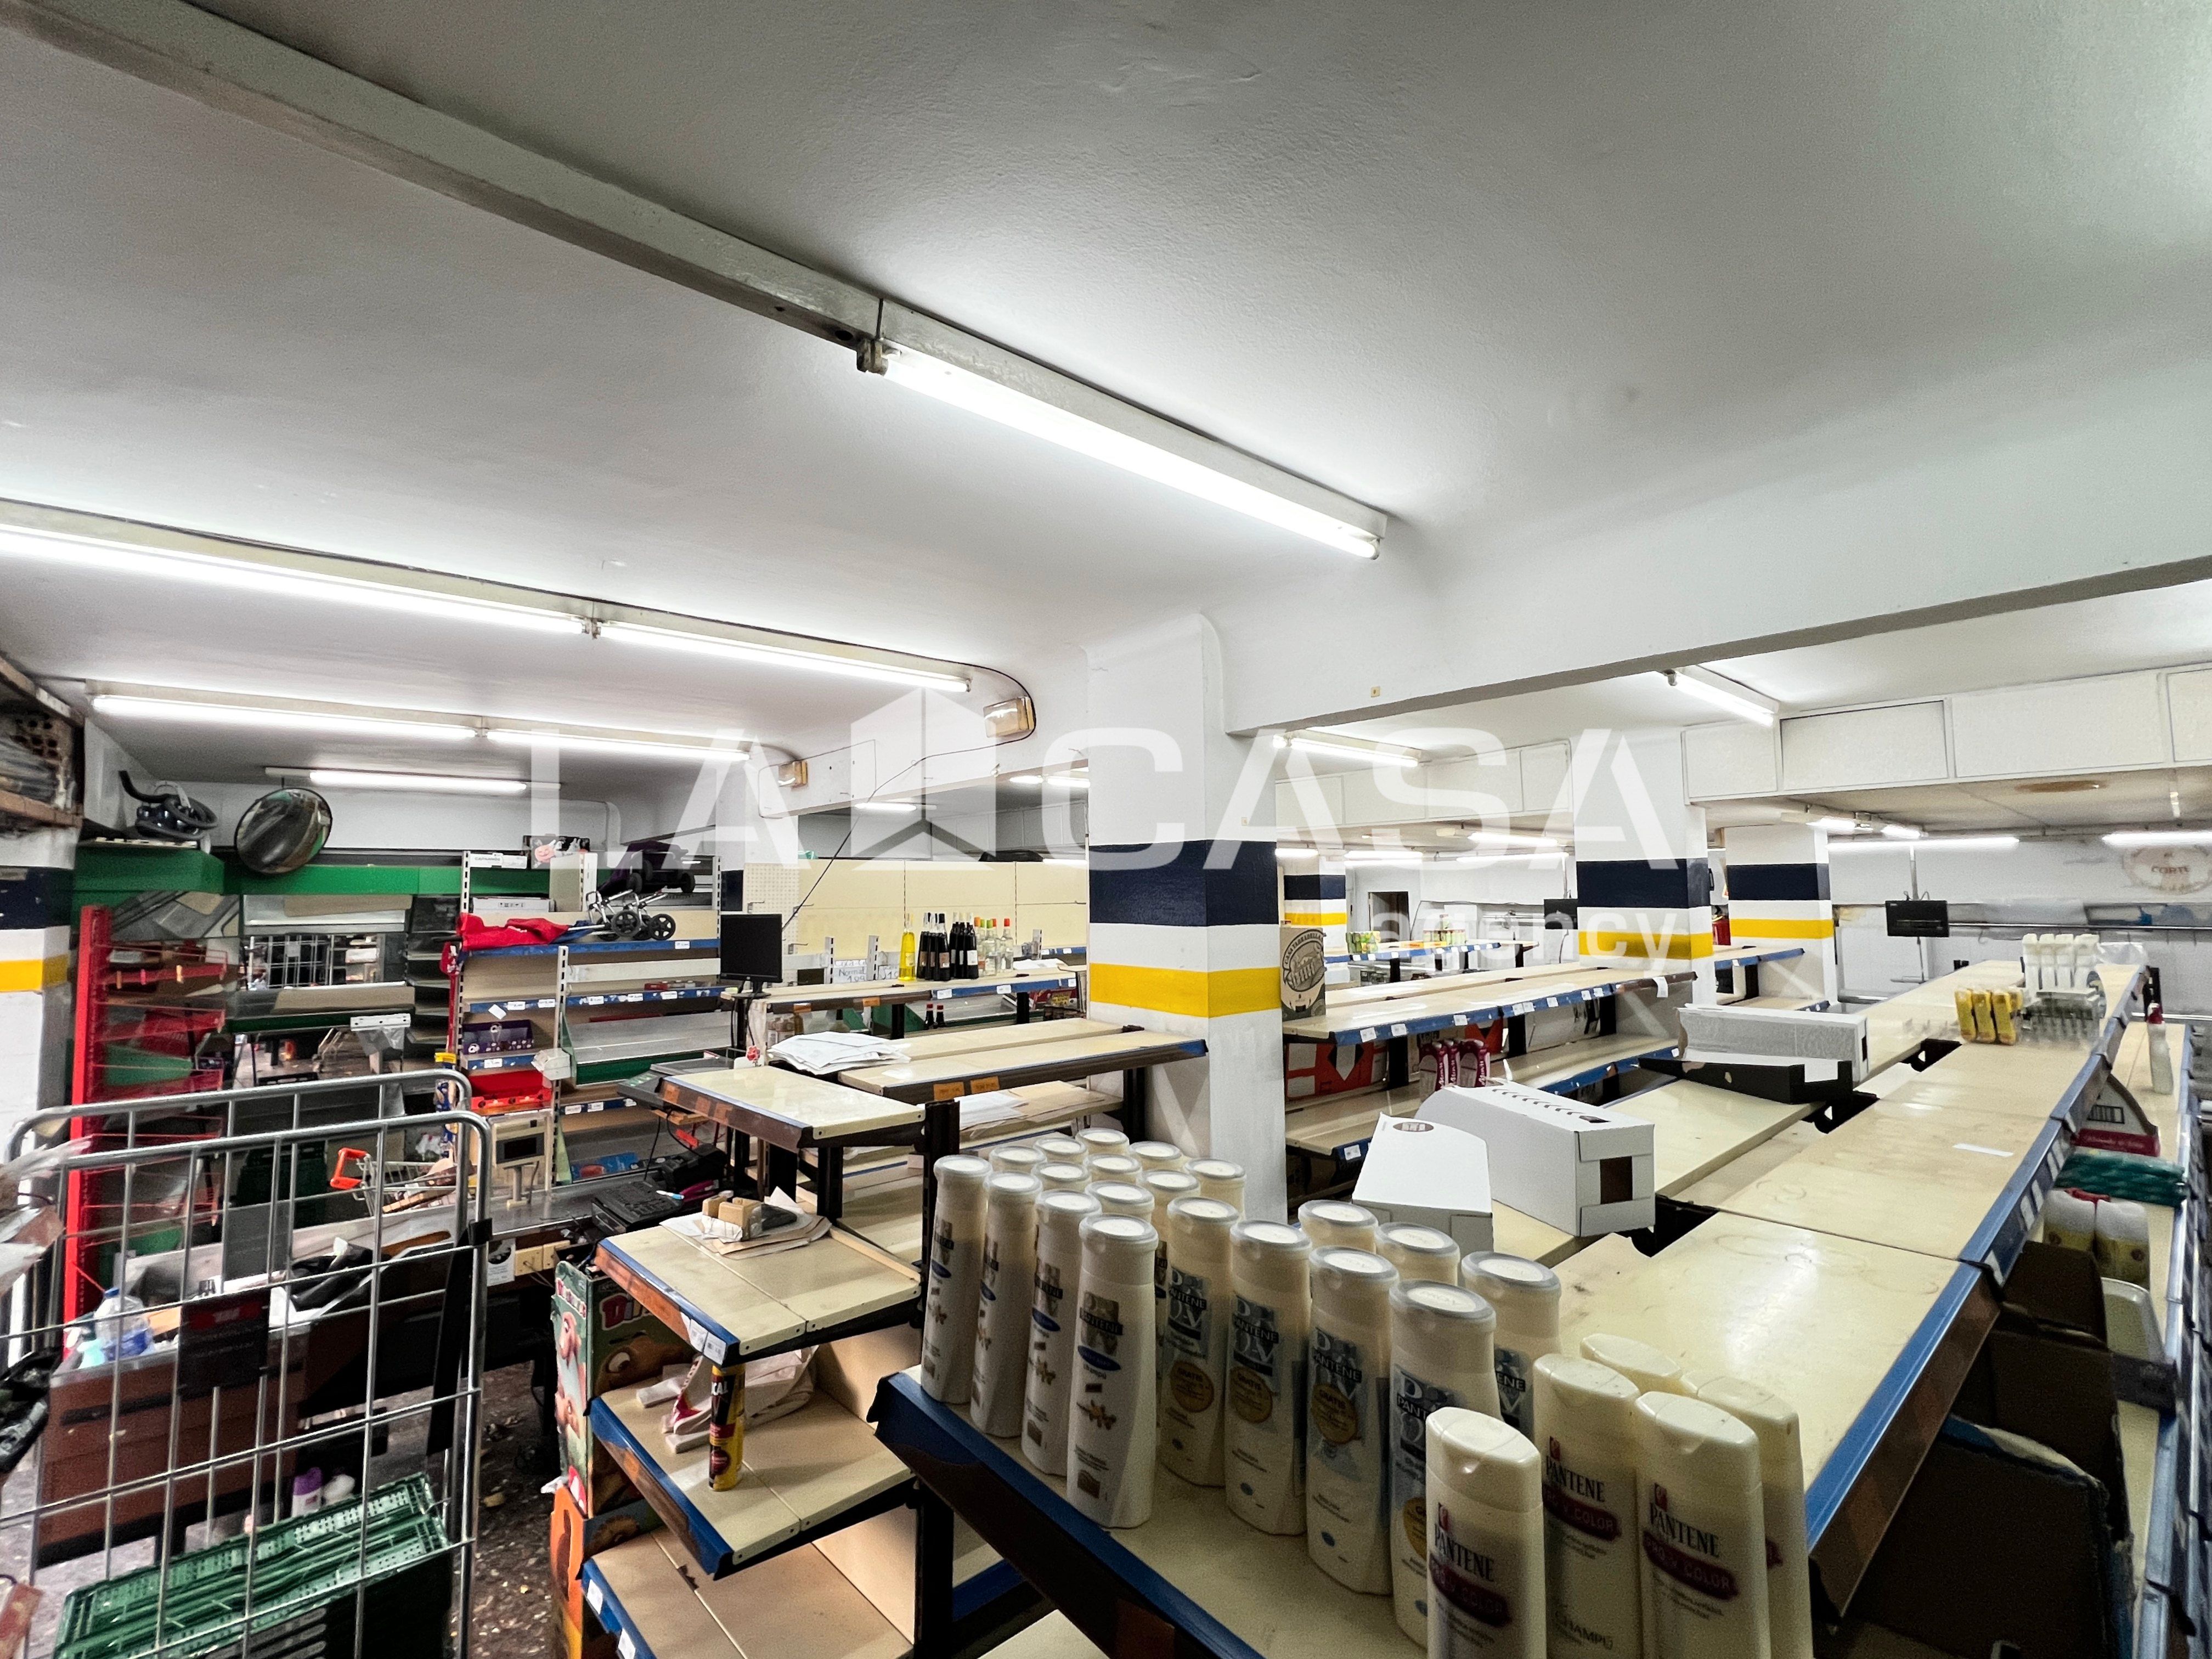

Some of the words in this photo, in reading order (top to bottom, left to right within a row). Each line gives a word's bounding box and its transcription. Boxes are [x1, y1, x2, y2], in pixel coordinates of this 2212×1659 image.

[839, 967, 865, 977] Normal
[1545, 1455, 1605, 1503] PANTENE
[1575, 1509, 1614, 1532] COLOR
[1649, 1502, 1719, 1559] PANTENE
[1435, 1523, 1494, 1583] PANTENE
[1684, 1564, 1729, 1589] COLOR
